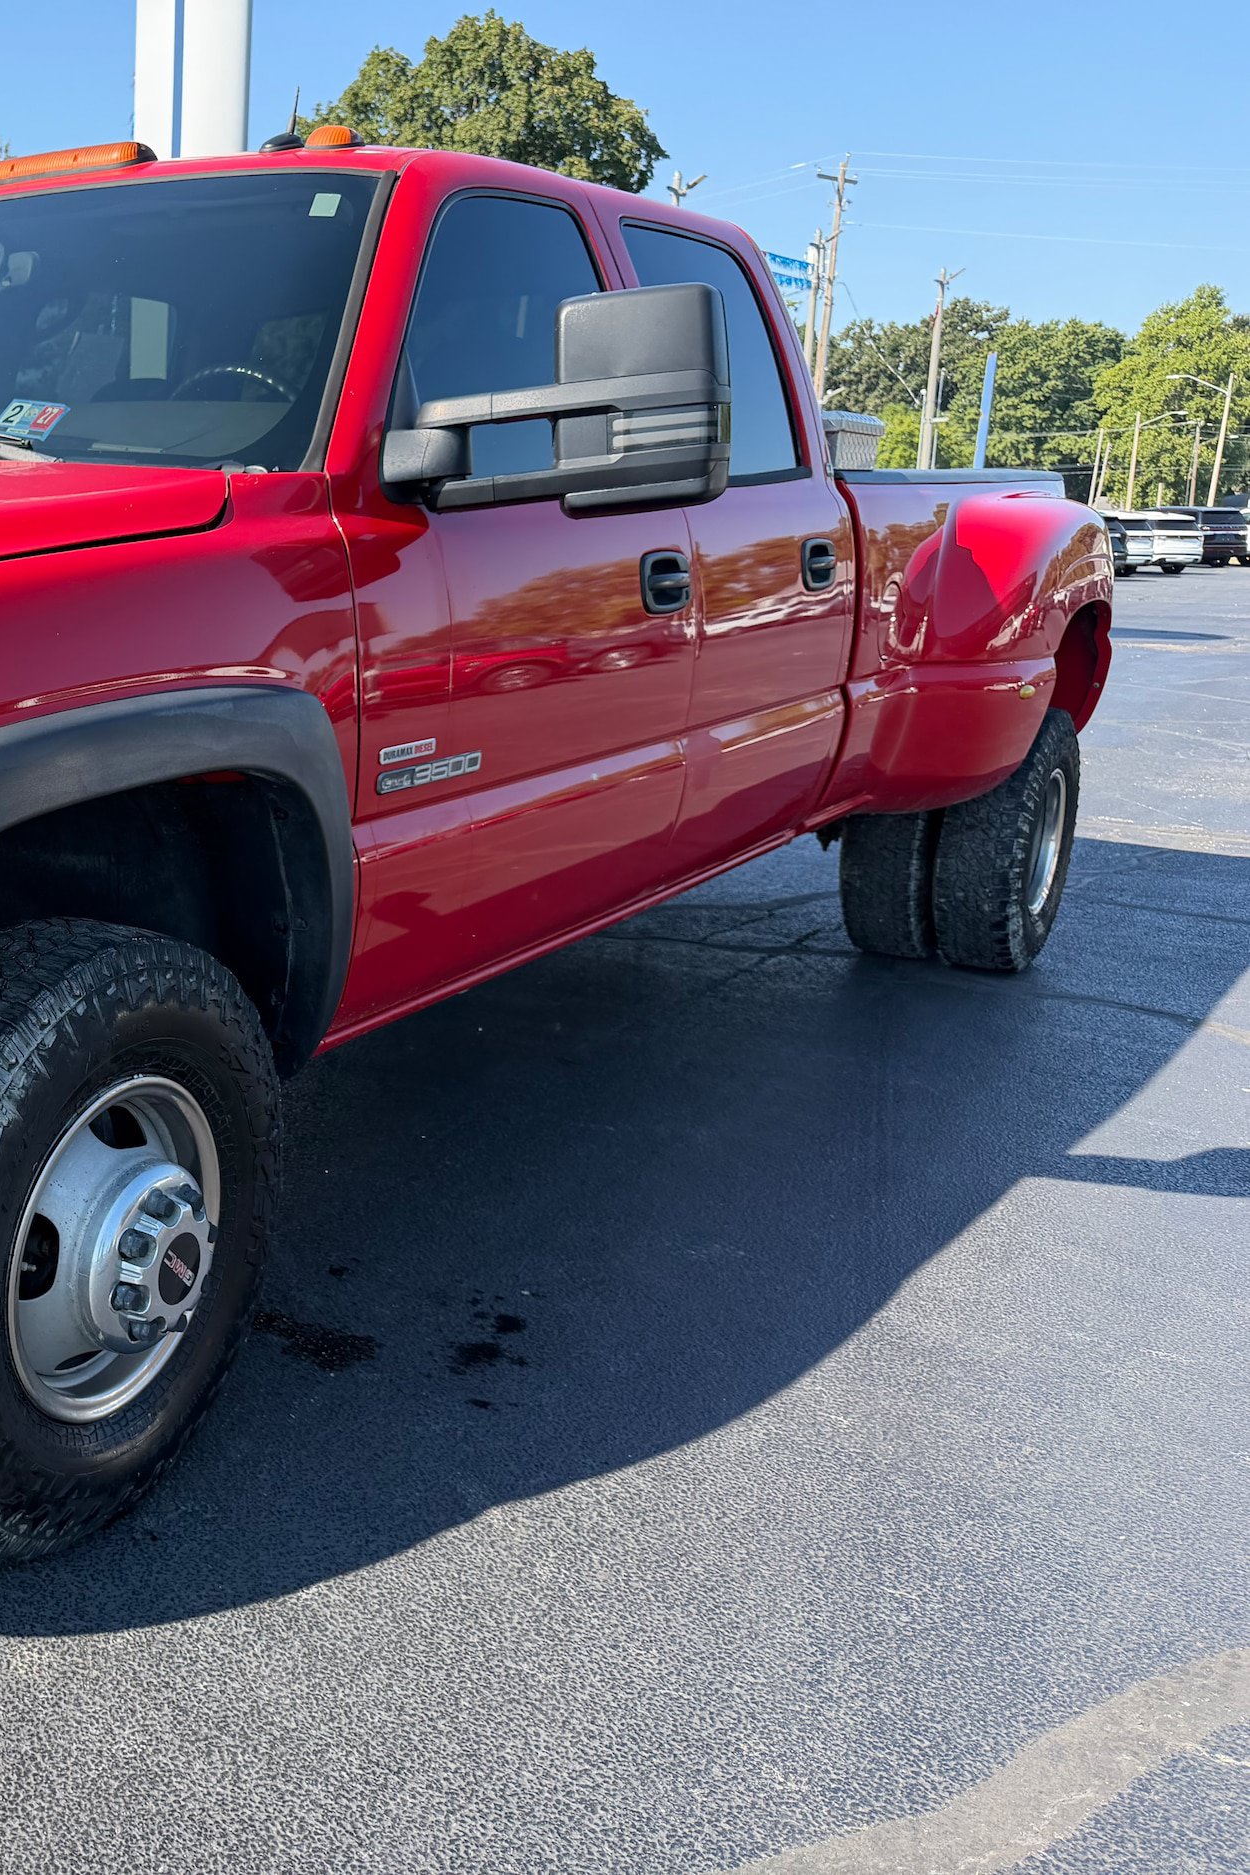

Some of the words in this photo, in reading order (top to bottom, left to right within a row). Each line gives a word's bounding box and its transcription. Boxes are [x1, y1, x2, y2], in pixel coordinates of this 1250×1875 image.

[2, 404, 24, 423] 2
[37, 406, 59, 425] 27
[383, 745, 413, 762] DURAMAX
[414, 742, 434, 755] DIESEL
[414, 752, 482, 785] 3500
[163, 1250, 196, 1288] GMC
